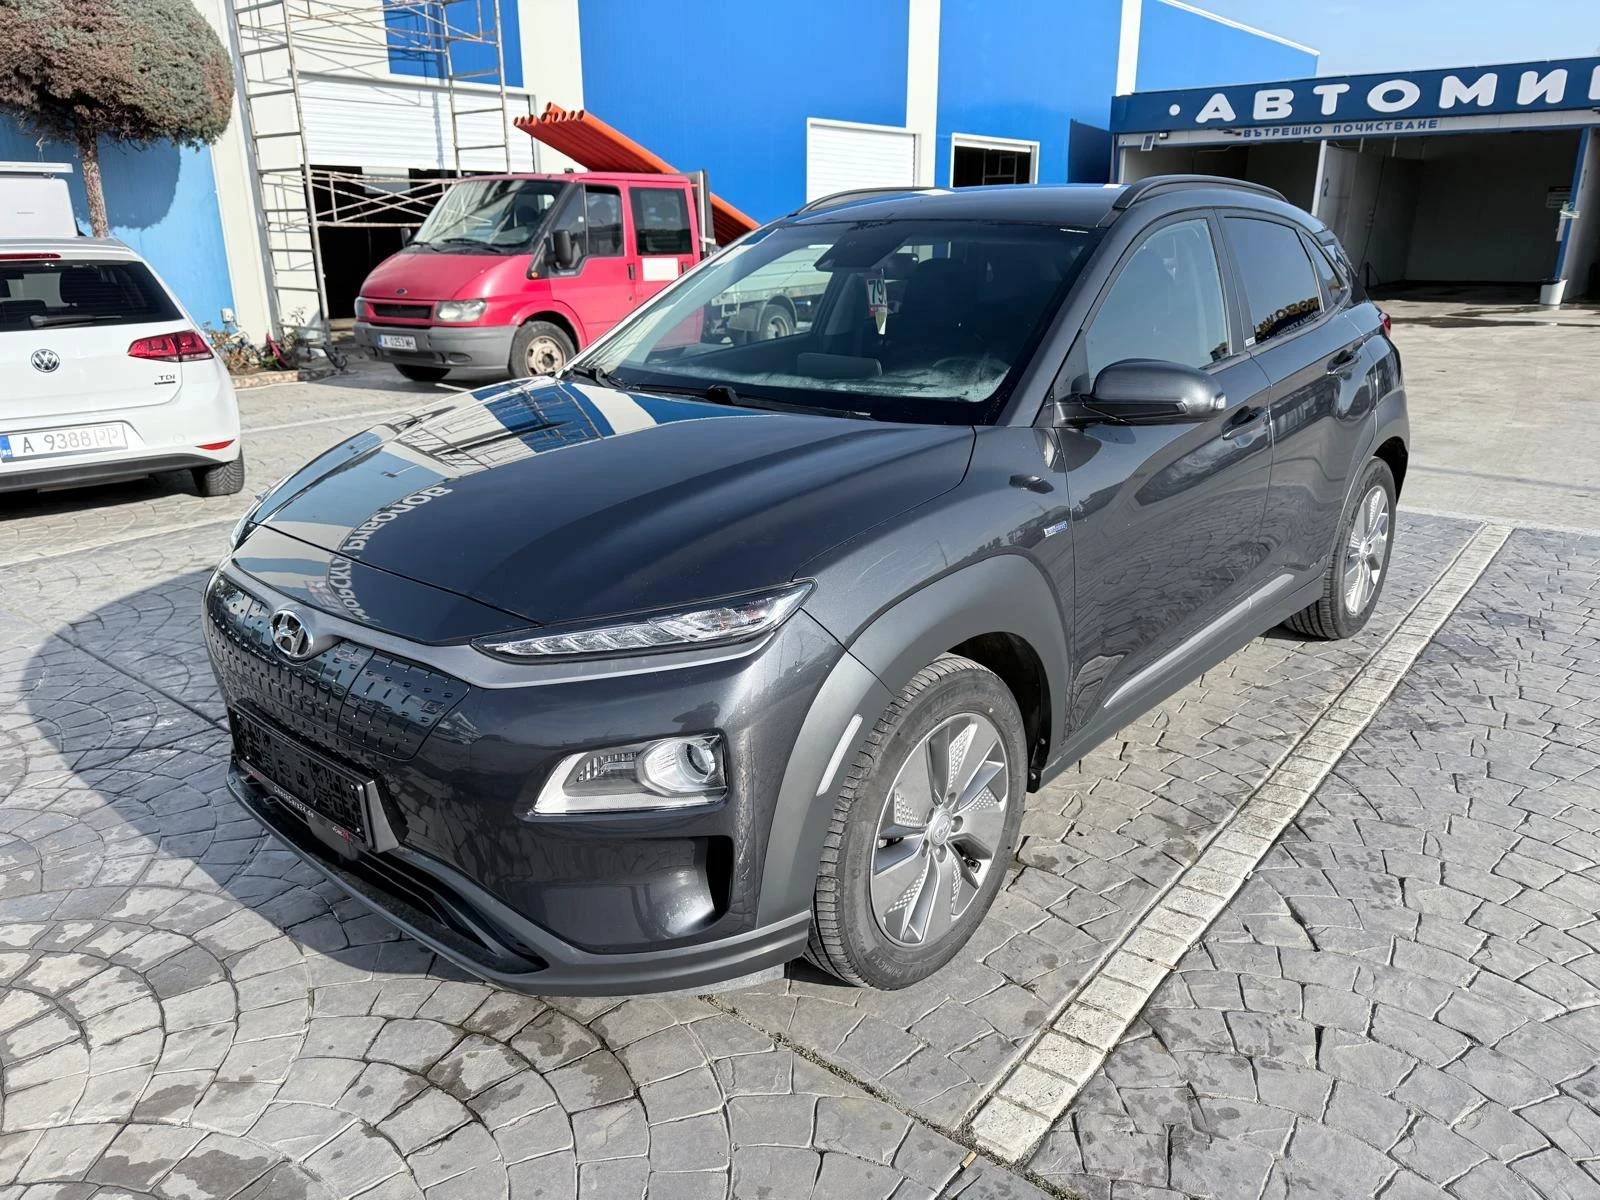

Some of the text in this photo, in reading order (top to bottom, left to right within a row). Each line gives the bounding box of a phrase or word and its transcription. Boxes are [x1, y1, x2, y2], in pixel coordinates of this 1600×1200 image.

[1195, 66, 1600, 123] АВТОМИ
[1243, 119, 1438, 138] ВЪТРЕШНО ПОЧИСТВАНЕ
[23, 437, 34, 453] A
[44, 430, 92, 451] 9388
